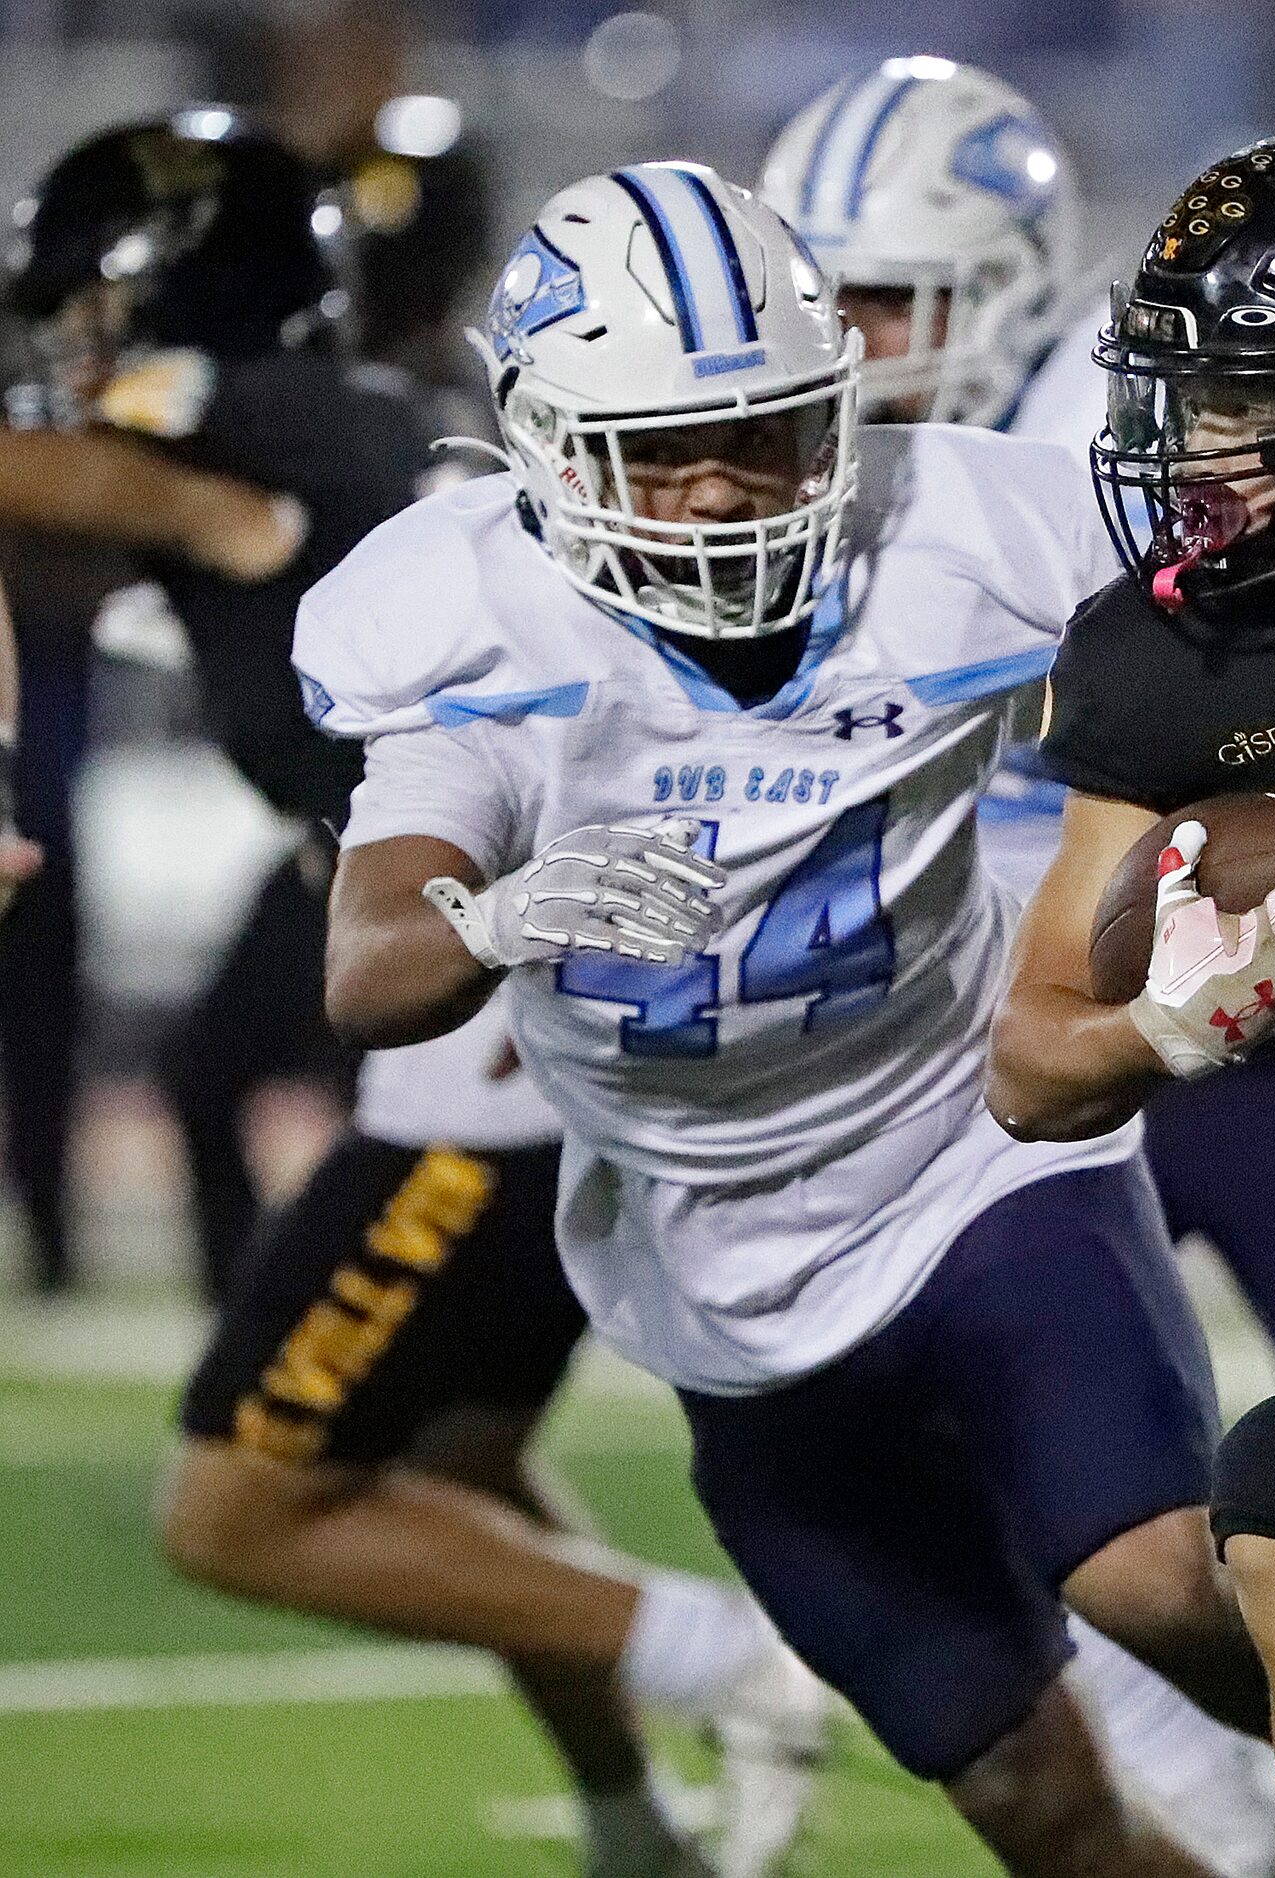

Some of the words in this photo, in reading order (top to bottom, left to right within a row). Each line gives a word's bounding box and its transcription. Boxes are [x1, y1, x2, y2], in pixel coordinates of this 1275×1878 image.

[1221, 175, 1242, 189] G
[1188, 196, 1208, 210] G
[1220, 201, 1246, 218] G
[1188, 219, 1210, 235] G
[653, 765, 726, 802] DUB
[744, 766, 840, 805] EAST
